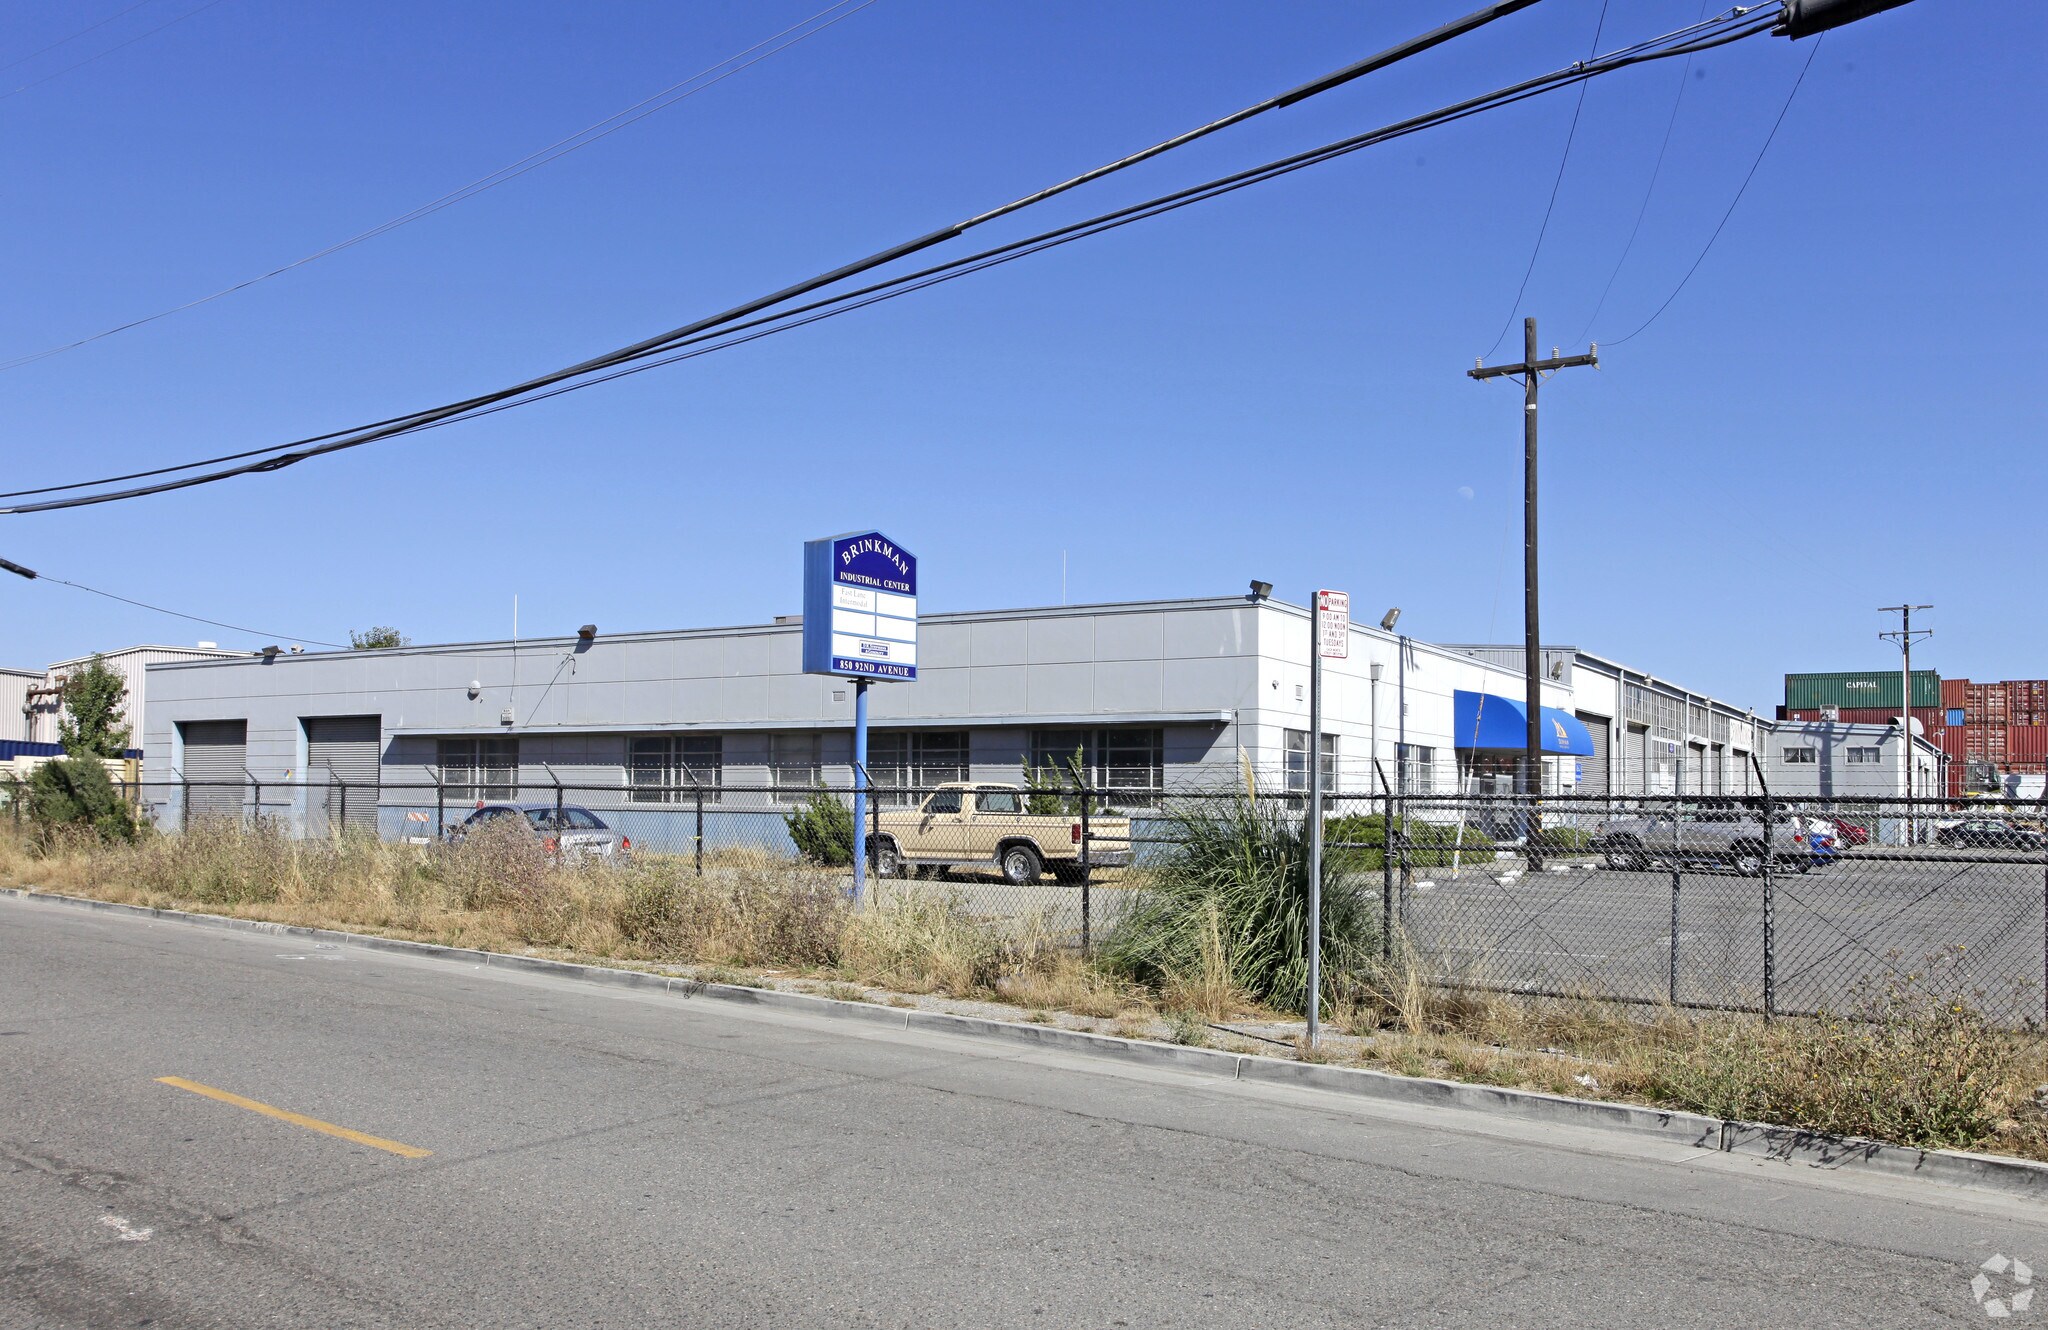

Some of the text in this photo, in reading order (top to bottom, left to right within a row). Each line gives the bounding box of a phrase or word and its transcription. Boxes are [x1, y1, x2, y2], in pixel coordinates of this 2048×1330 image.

[842, 539, 909, 575] BRINKMAN
[840, 572, 910, 592] INDUSTRIAL CENTER
[1320, 595, 1347, 608] NO PARKING
[1323, 638, 1343, 647] TUESDAYS
[840, 660, 909, 677] 850 92ND AVENUE
